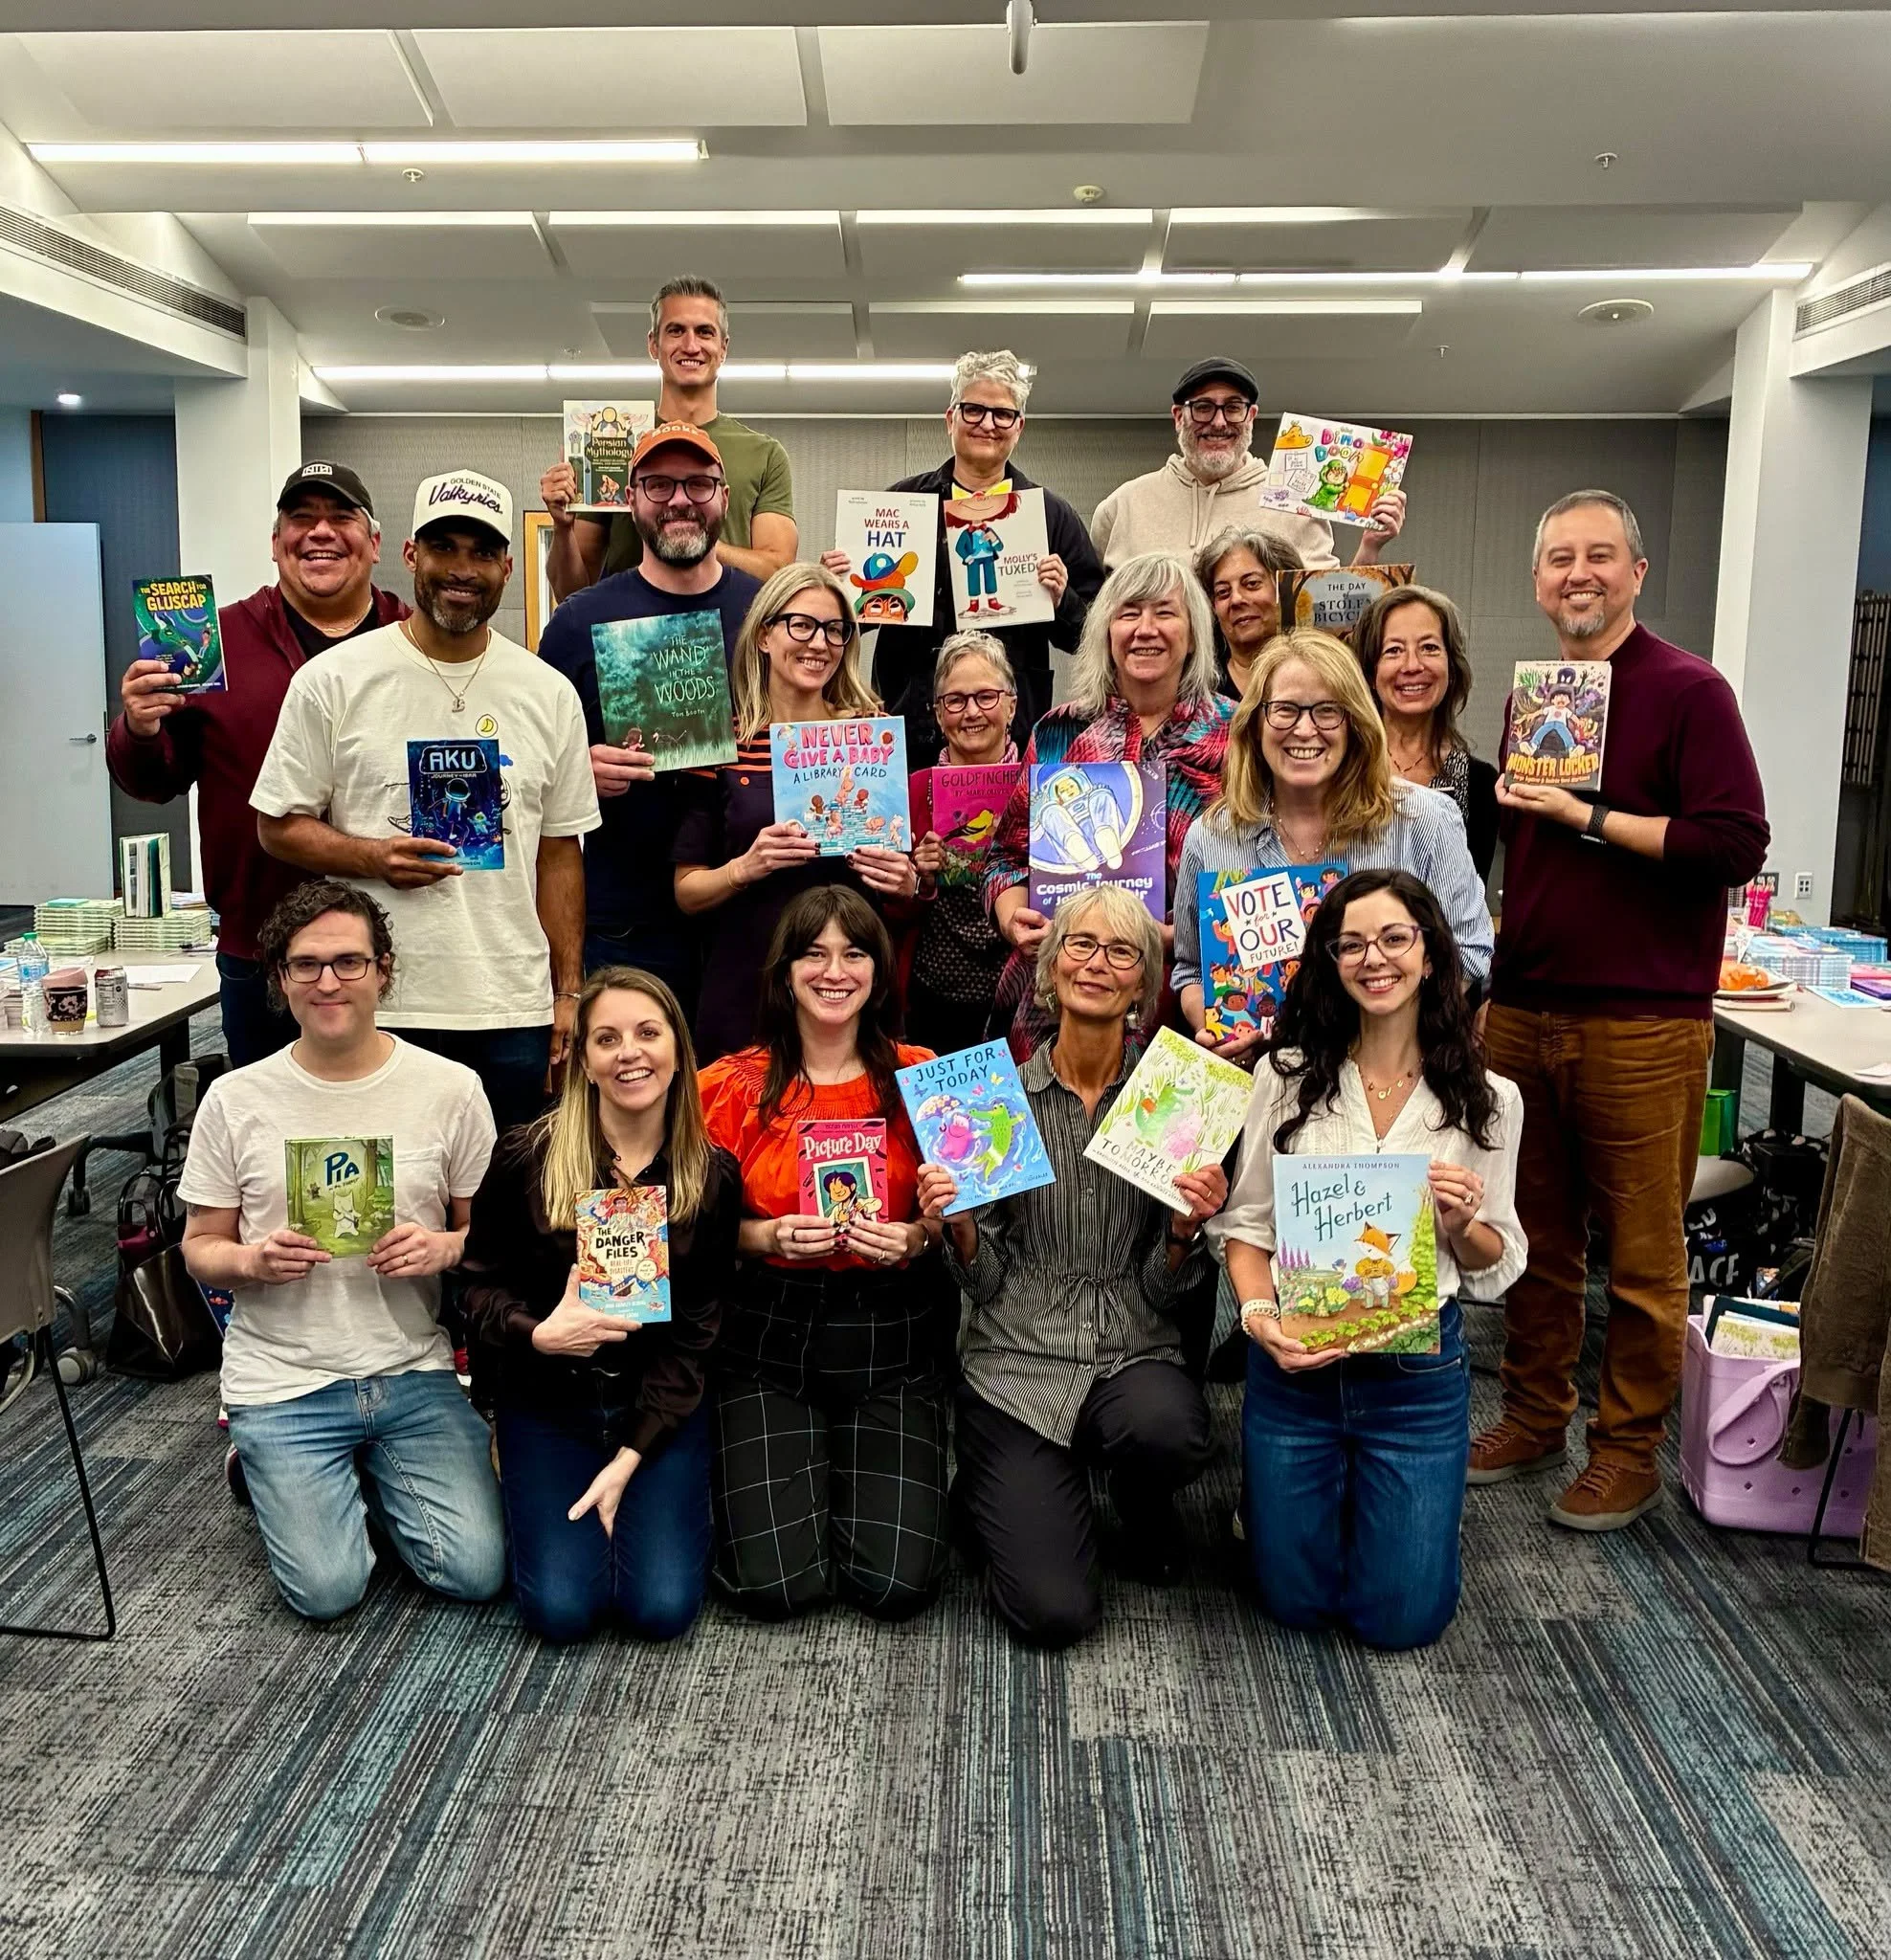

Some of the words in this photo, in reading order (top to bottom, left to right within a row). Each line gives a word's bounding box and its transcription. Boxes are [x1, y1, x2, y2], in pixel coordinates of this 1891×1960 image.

[591, 436, 627, 448] Persian
[585, 447, 634, 458] Mythology
[428, 482, 503, 515] Valkyries
[450, 478, 481, 488] GOLDEN
[482, 483, 501, 500] STATE
[875, 508, 901, 518] MAC
[864, 518, 901, 529] WEARS
[902, 520, 910, 529] A
[867, 530, 906, 548] HAT
[1003, 552, 1038, 565] MOLLY'S
[997, 562, 1038, 576] TUXED
[150, 581, 197, 596] SEARCH
[1326, 583, 1345, 591] THE
[1348, 582, 1367, 590] DAY
[146, 593, 207, 612] GLUSCAP
[670, 635, 688, 646] THE
[653, 645, 706, 671] WAND
[655, 676, 716, 704] WOODS
[800, 723, 874, 749] NEVER
[429, 749, 477, 771] AKU
[783, 749, 829, 769] GIVE
[833, 748, 845, 764] A
[848, 746, 895, 766] BABY
[1506, 752, 1557, 777] MONSTER
[1560, 752, 1600, 776] LOCKER
[793, 773, 801, 785] A
[803, 767, 844, 782] LIBRARY
[854, 766, 887, 778] CARD
[1085, 872, 1102, 881] The
[1035, 882, 1091, 896] Cosmic
[1042, 897, 1053, 905] of
[1226, 880, 1291, 920] VOTE
[1254, 912, 1271, 926] for
[1239, 919, 1300, 951] OUR
[1250, 941, 1300, 964] FUTURE!
[916, 1058, 957, 1082] JUST
[964, 1047, 996, 1068] FOR
[935, 1064, 990, 1093] TODAY
[802, 1135, 854, 1161] Picture
[853, 1131, 883, 1154] Day
[1101, 1137, 1177, 1187] TOMORRO
[1125, 1141, 1177, 1173] MAYBE
[1301, 1162, 1351, 1170] ALEXANDRA
[323, 1151, 360, 1187] PIA
[1290, 1172, 1350, 1217] Hazel
[1353, 1180, 1367, 1196] &
[1314, 1192, 1392, 1242] Herbert
[595, 1231, 647, 1250] DANGER
[597, 1227, 612, 1236] THE
[606, 1246, 638, 1259] FILES
